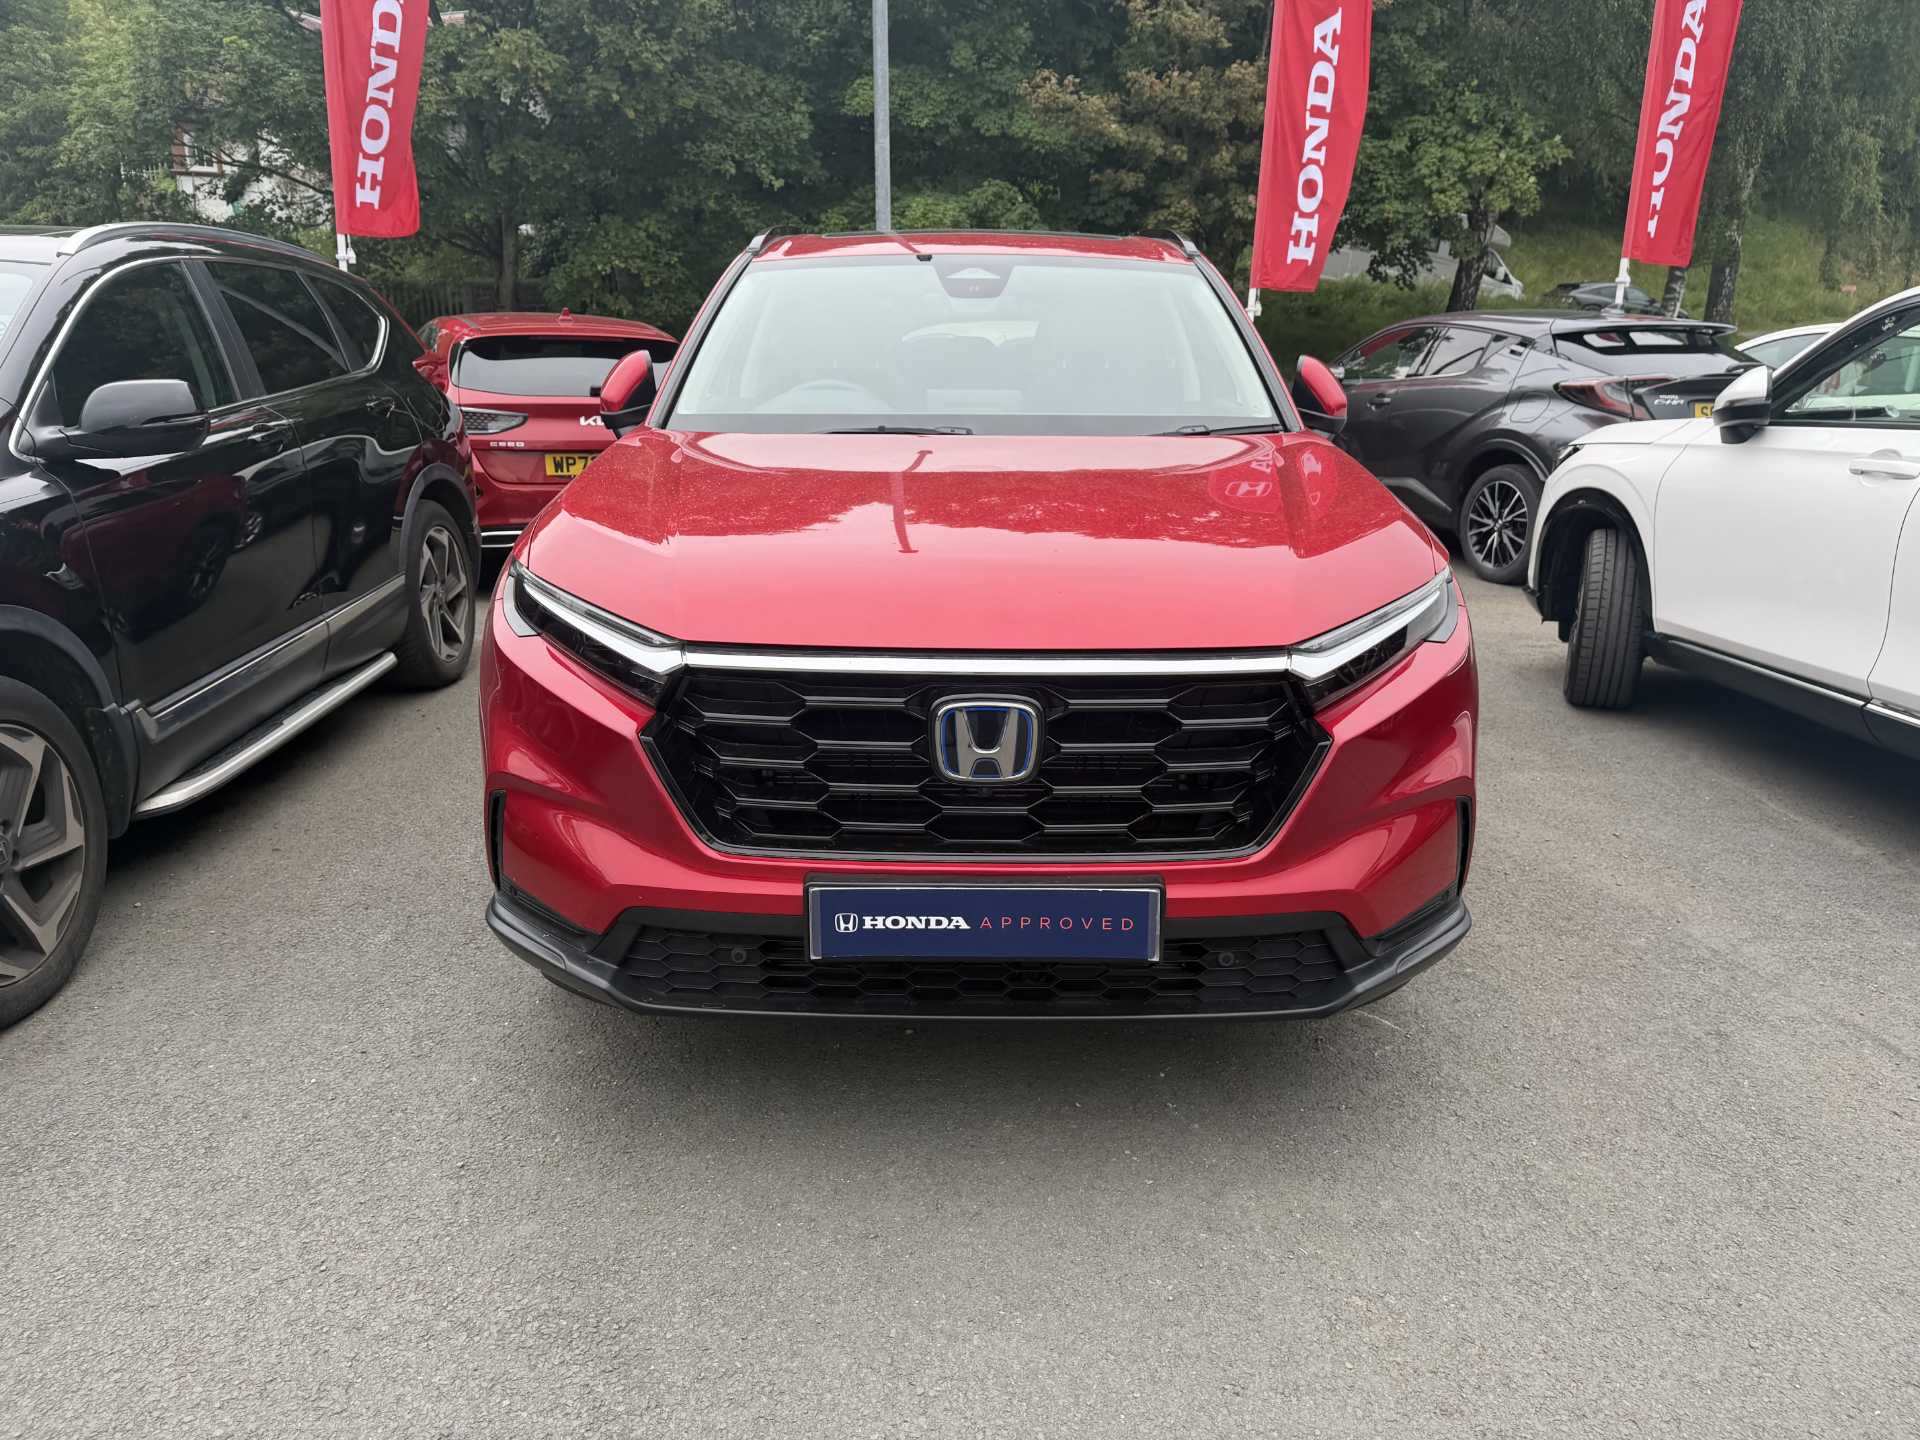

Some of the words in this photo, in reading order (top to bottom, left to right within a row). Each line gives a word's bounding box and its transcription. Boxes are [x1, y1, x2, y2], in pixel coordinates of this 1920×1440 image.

[355, 0, 403, 210] HOND
[1286, 6, 1342, 266] HONDA
[552, 456, 599, 473] WP7
[862, 916, 971, 930] HONDA
[980, 916, 1135, 931] APPROVED
